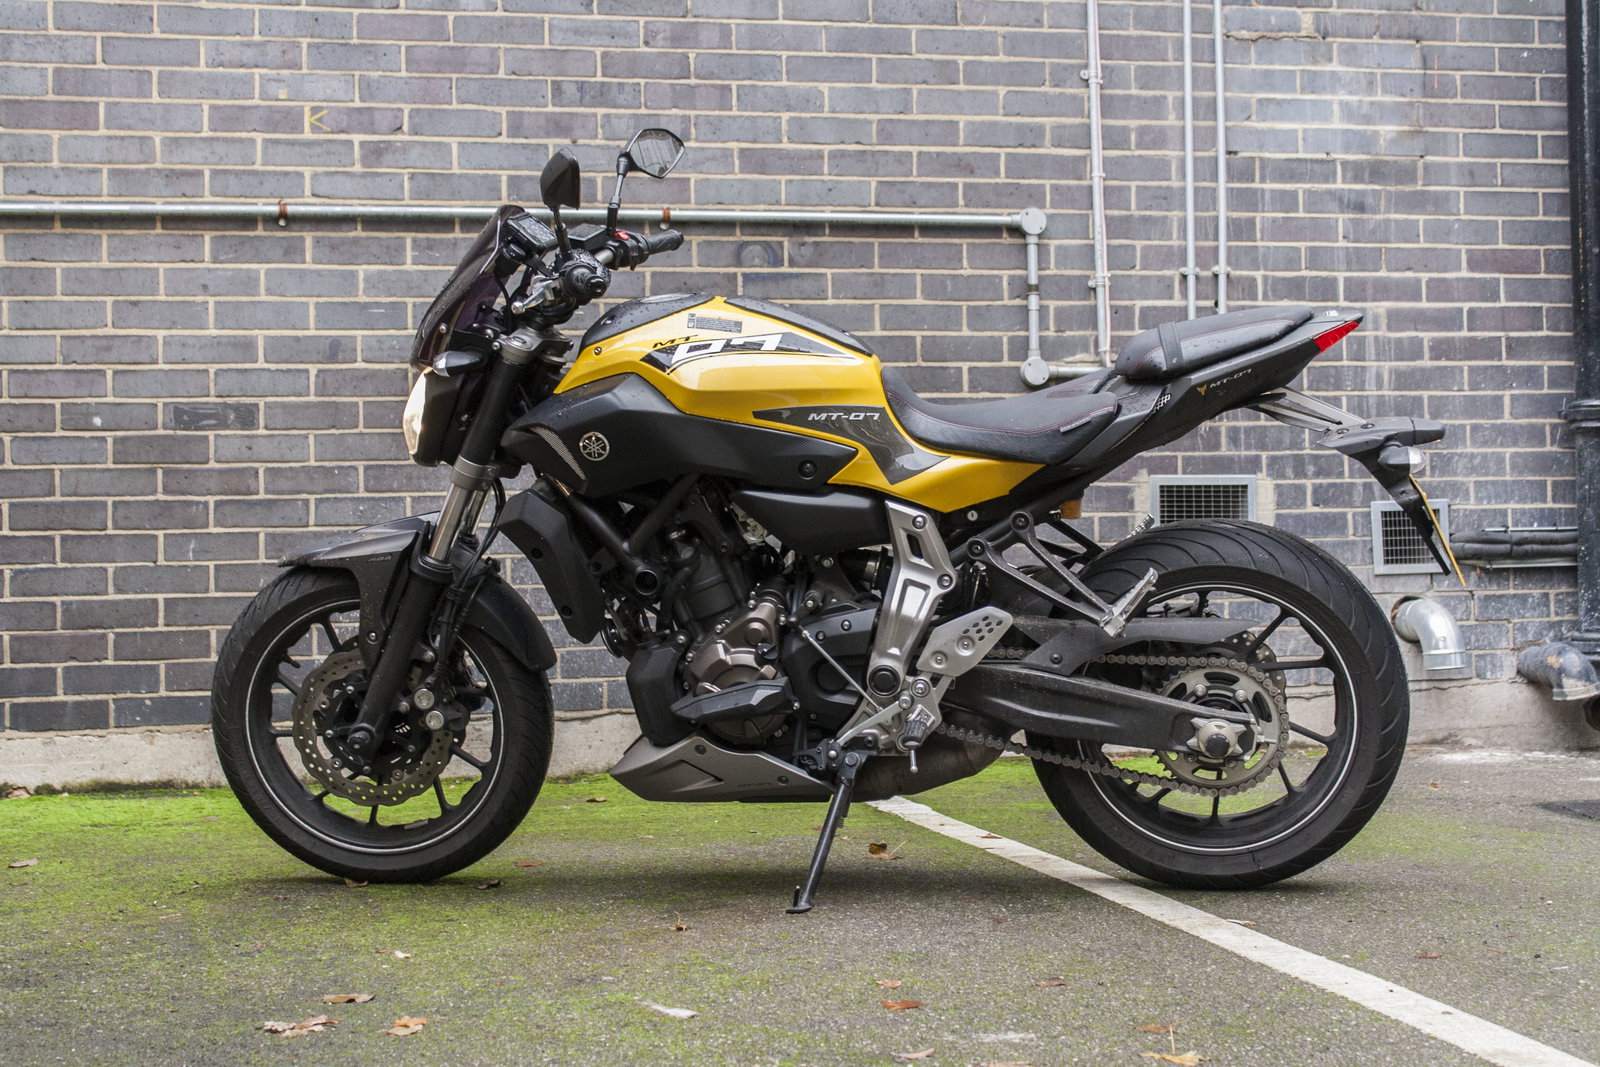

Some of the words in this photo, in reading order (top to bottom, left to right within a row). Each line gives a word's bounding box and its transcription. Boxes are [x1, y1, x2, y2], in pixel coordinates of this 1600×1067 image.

[652, 334, 699, 349] MT
[671, 333, 783, 365] 07
[1209, 368, 1252, 388] MT-07
[807, 412, 881, 421] MT-07
